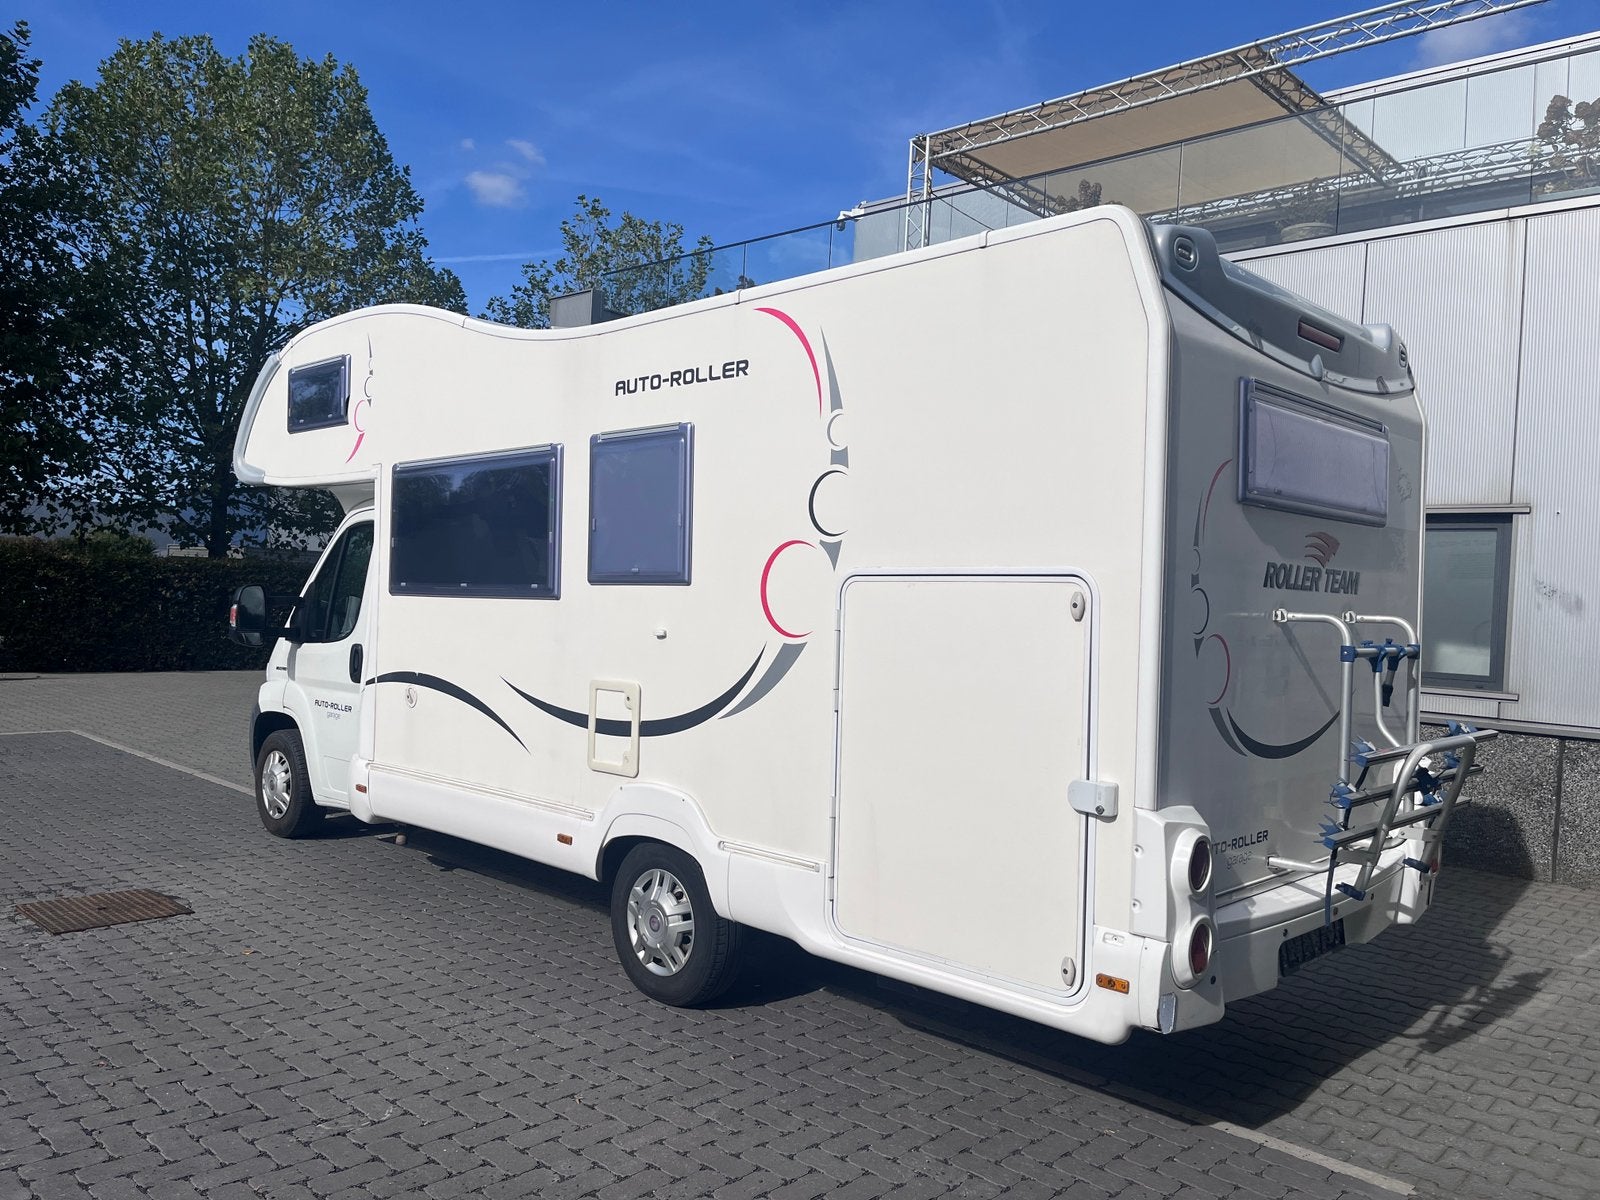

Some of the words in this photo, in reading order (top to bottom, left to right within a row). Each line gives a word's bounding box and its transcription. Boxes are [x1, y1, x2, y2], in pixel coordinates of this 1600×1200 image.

[615, 358, 750, 397] AUTO-ROLLER
[1263, 561, 1322, 593] ROLLER
[1324, 567, 1361, 596] TEAM
[314, 699, 353, 713] AUTO-ROLLER
